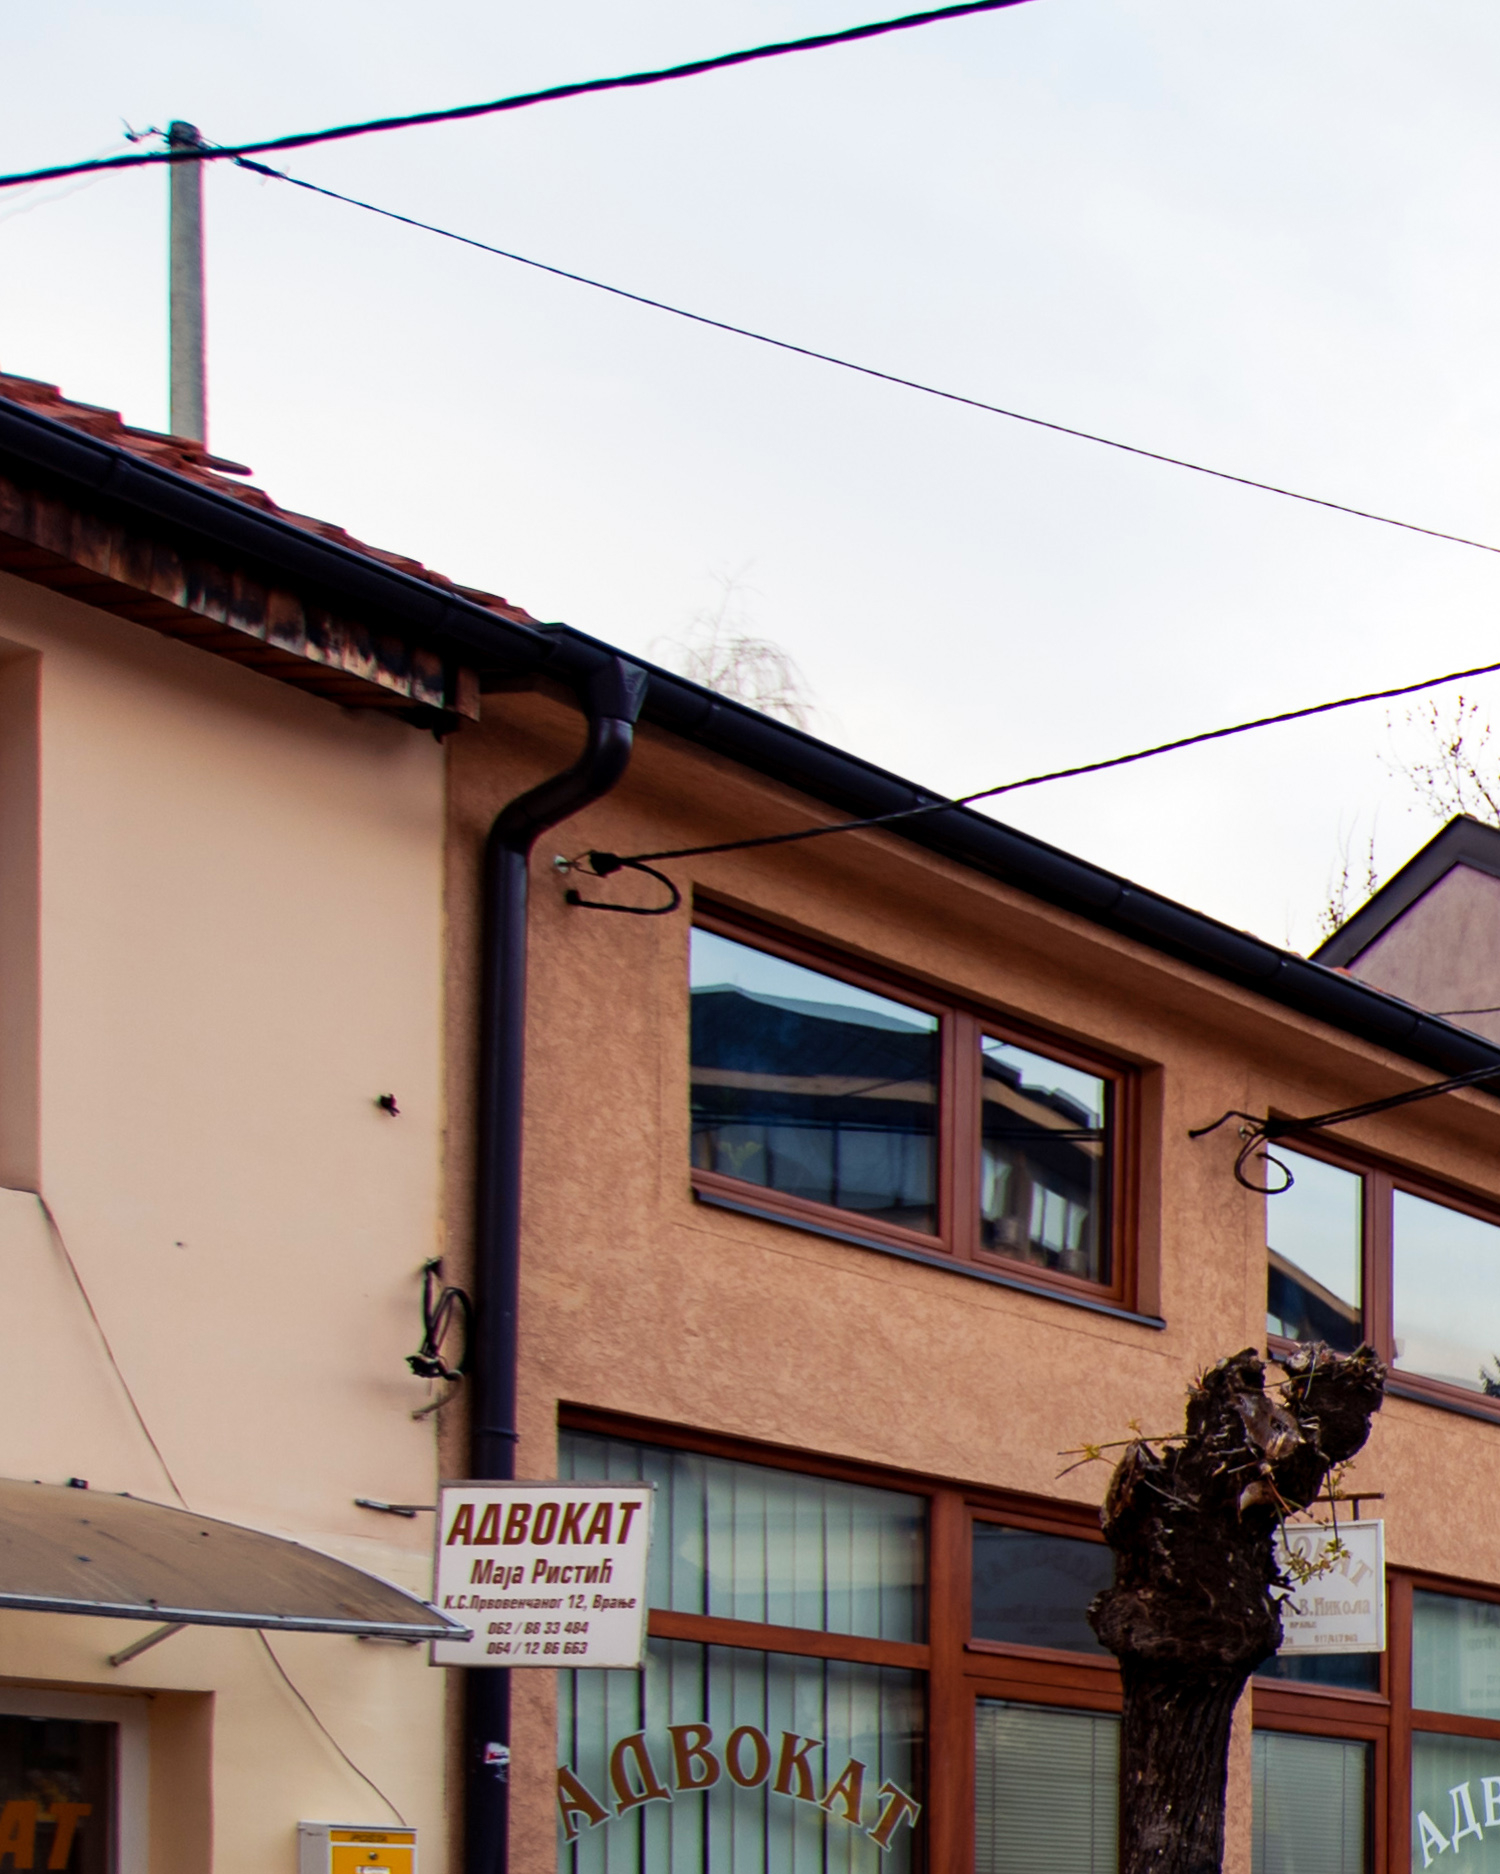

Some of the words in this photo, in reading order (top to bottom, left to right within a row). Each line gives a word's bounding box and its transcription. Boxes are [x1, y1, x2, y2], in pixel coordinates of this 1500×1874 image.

[445, 1501, 643, 1546] АДВОКАТ
[470, 1559, 525, 1590] Маја
[531, 1558, 613, 1585] Ристић
[444, 1594, 564, 1613] К.С.Првовенчаног
[592, 1594, 637, 1612] Врање
[543, 1621, 561, 1634] 33
[524, 1642, 540, 1654] 12
[557, 1721, 923, 1853] АДВОКАТ
